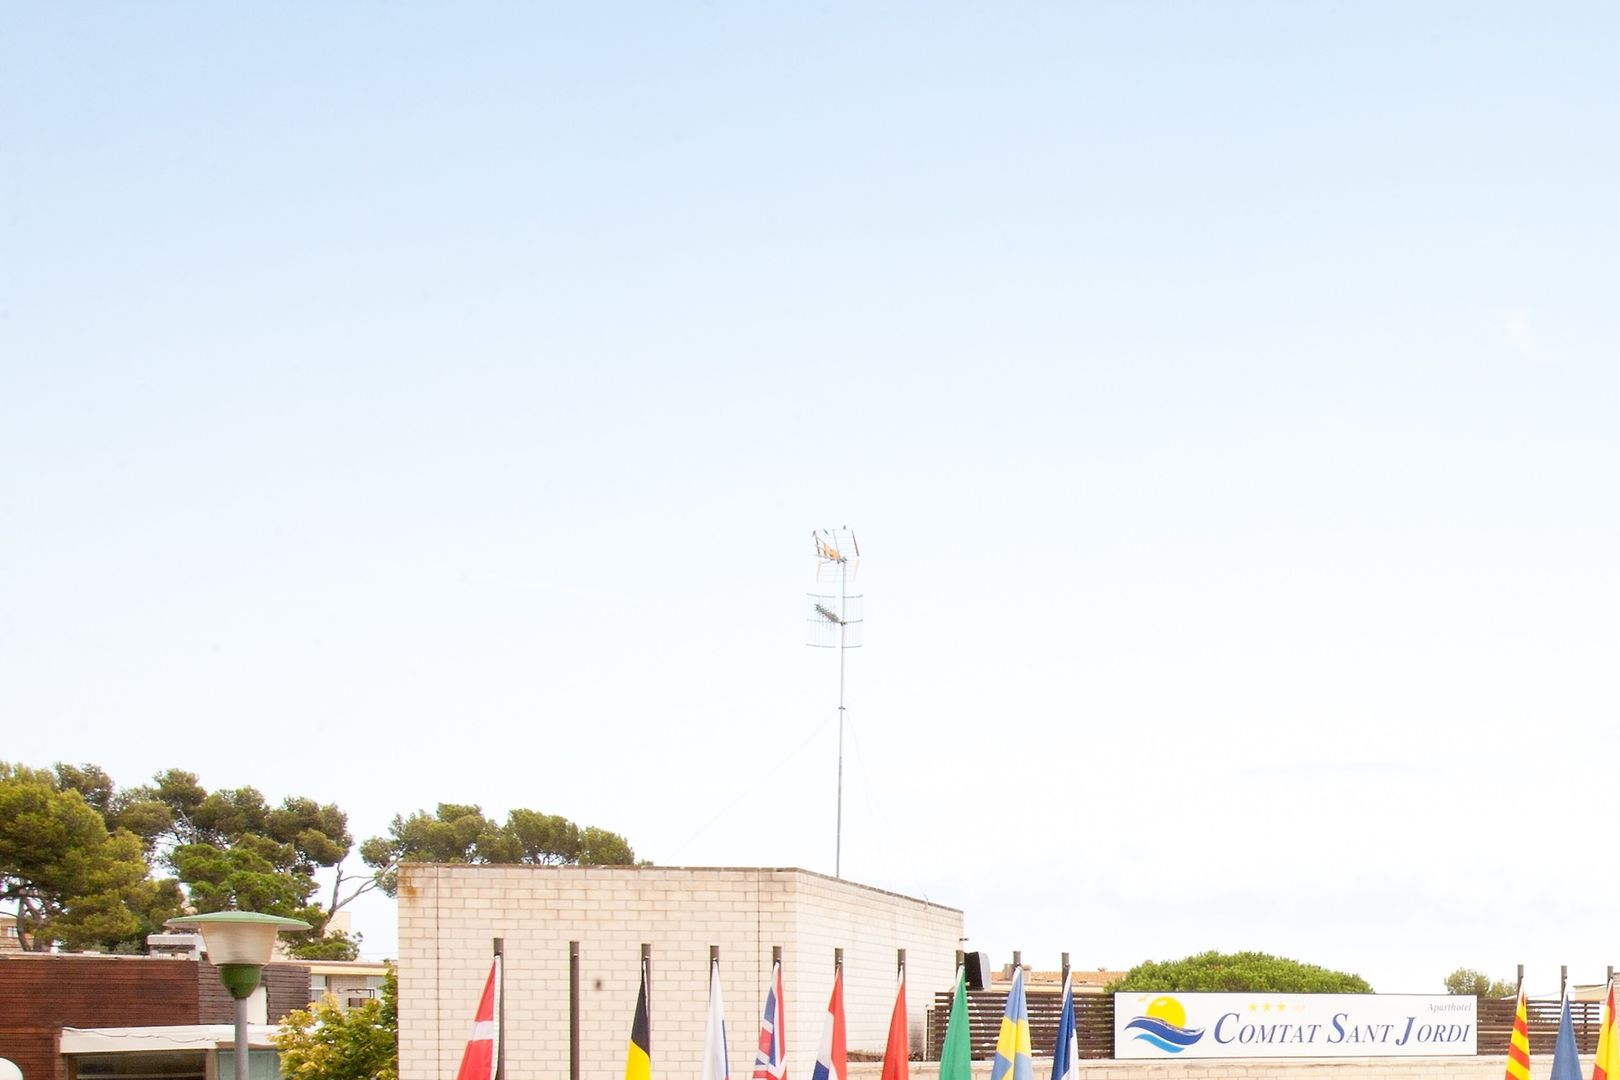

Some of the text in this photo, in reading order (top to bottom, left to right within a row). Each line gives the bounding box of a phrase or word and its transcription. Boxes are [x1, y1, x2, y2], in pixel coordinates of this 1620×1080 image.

[1427, 1002, 1471, 1013] Aparthotel
[1214, 1012, 1470, 1046] COMTAT SANT JORDI
